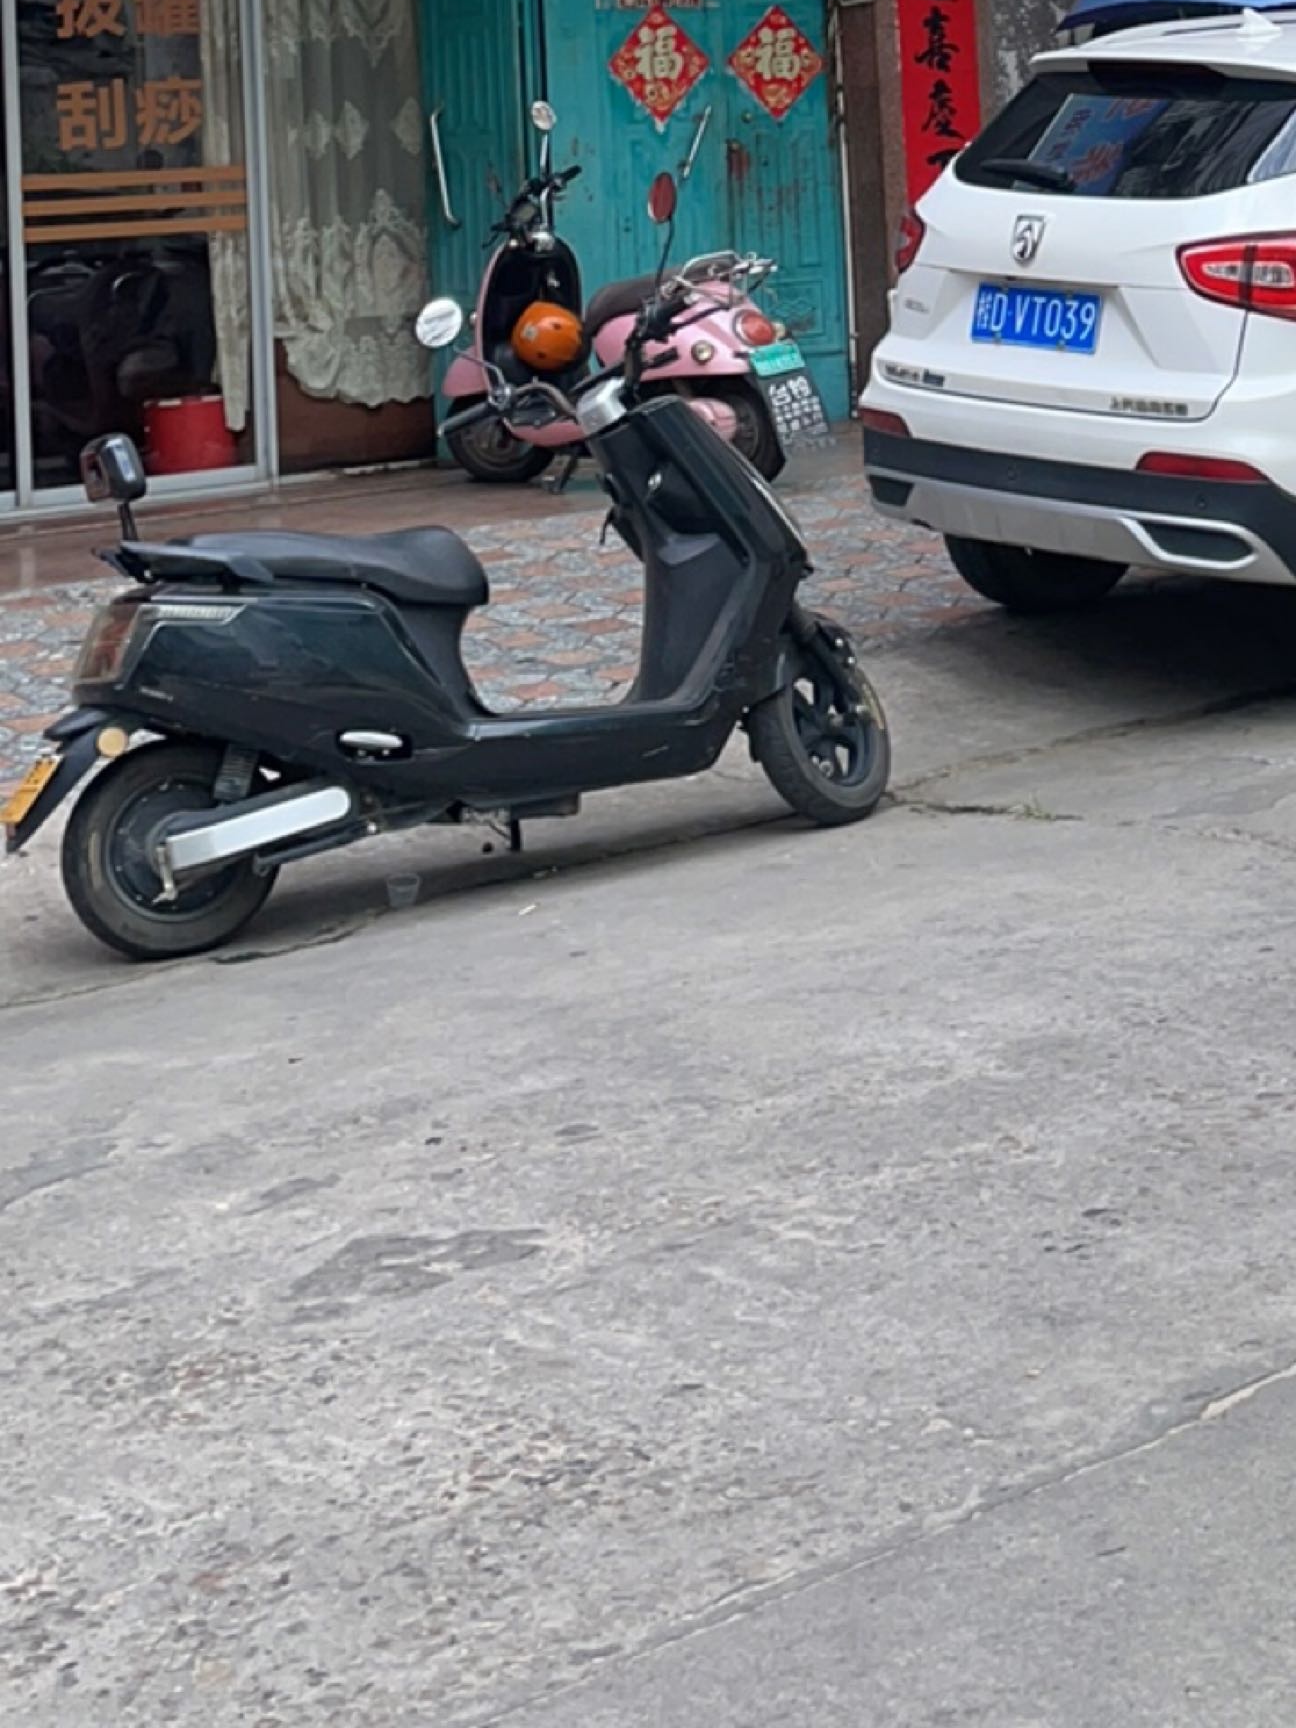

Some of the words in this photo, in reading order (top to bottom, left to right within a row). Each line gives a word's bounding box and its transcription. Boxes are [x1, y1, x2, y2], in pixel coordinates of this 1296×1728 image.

[634, 25, 683, 80] 福
[755, 26, 800, 80] 福
[55, 76, 202, 150] 刮痧
